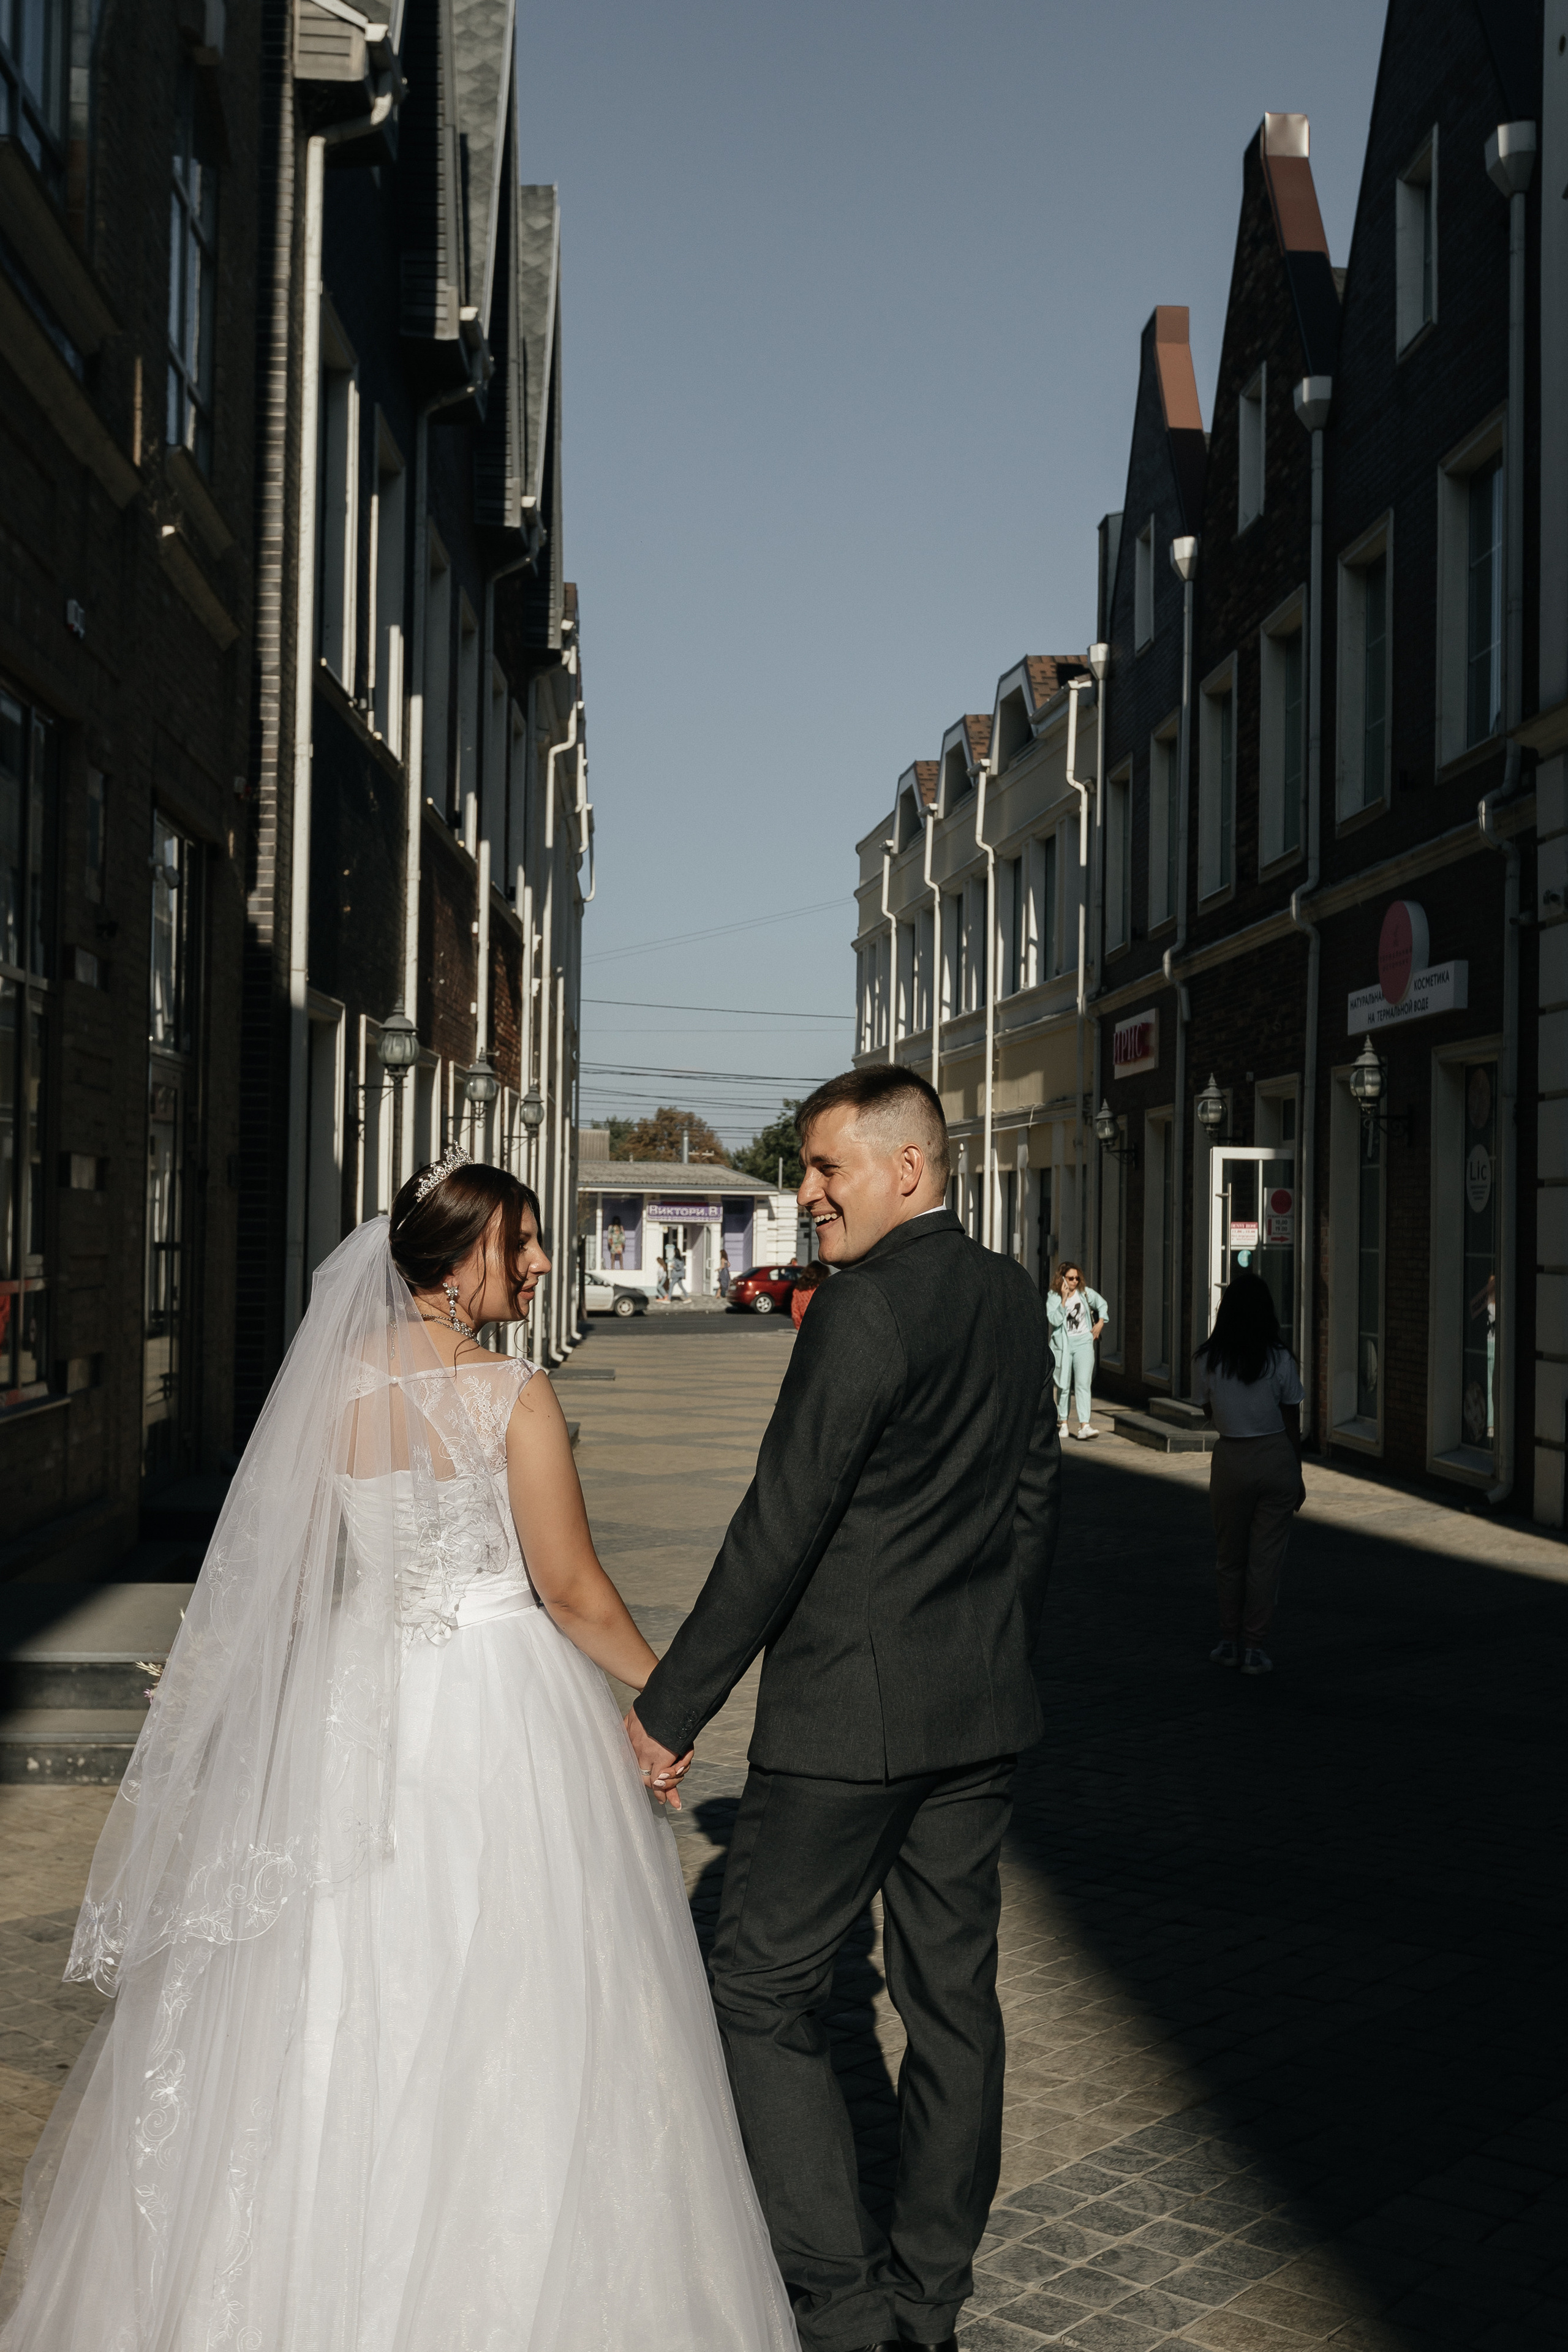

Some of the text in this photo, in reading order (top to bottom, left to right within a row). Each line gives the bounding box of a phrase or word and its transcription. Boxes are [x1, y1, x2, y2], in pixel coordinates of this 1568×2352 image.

[1414, 970, 1450, 990] КОСМЕТИКА
[1368, 997, 1428, 1024] НА ТЕРМАЛЬНОЙ ВОДЕ
[1113, 1023, 1142, 1065] ИРИС
